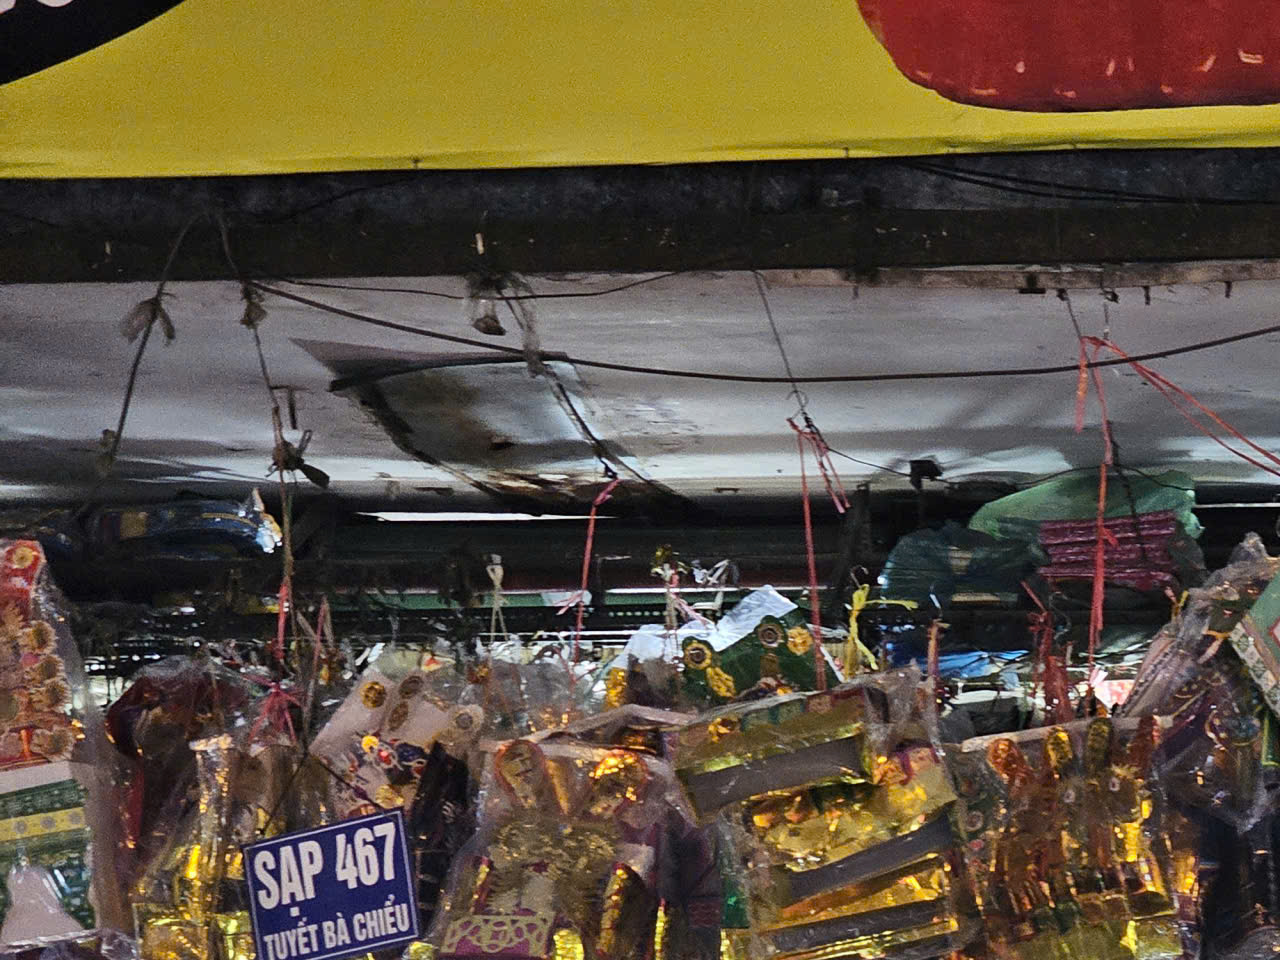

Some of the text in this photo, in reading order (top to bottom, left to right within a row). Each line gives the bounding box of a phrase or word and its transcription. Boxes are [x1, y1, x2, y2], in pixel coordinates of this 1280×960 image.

[254, 822, 396, 917] SẠP 467
[322, 912, 351, 949] BÀ
[353, 894, 410, 942] CHIỂU
